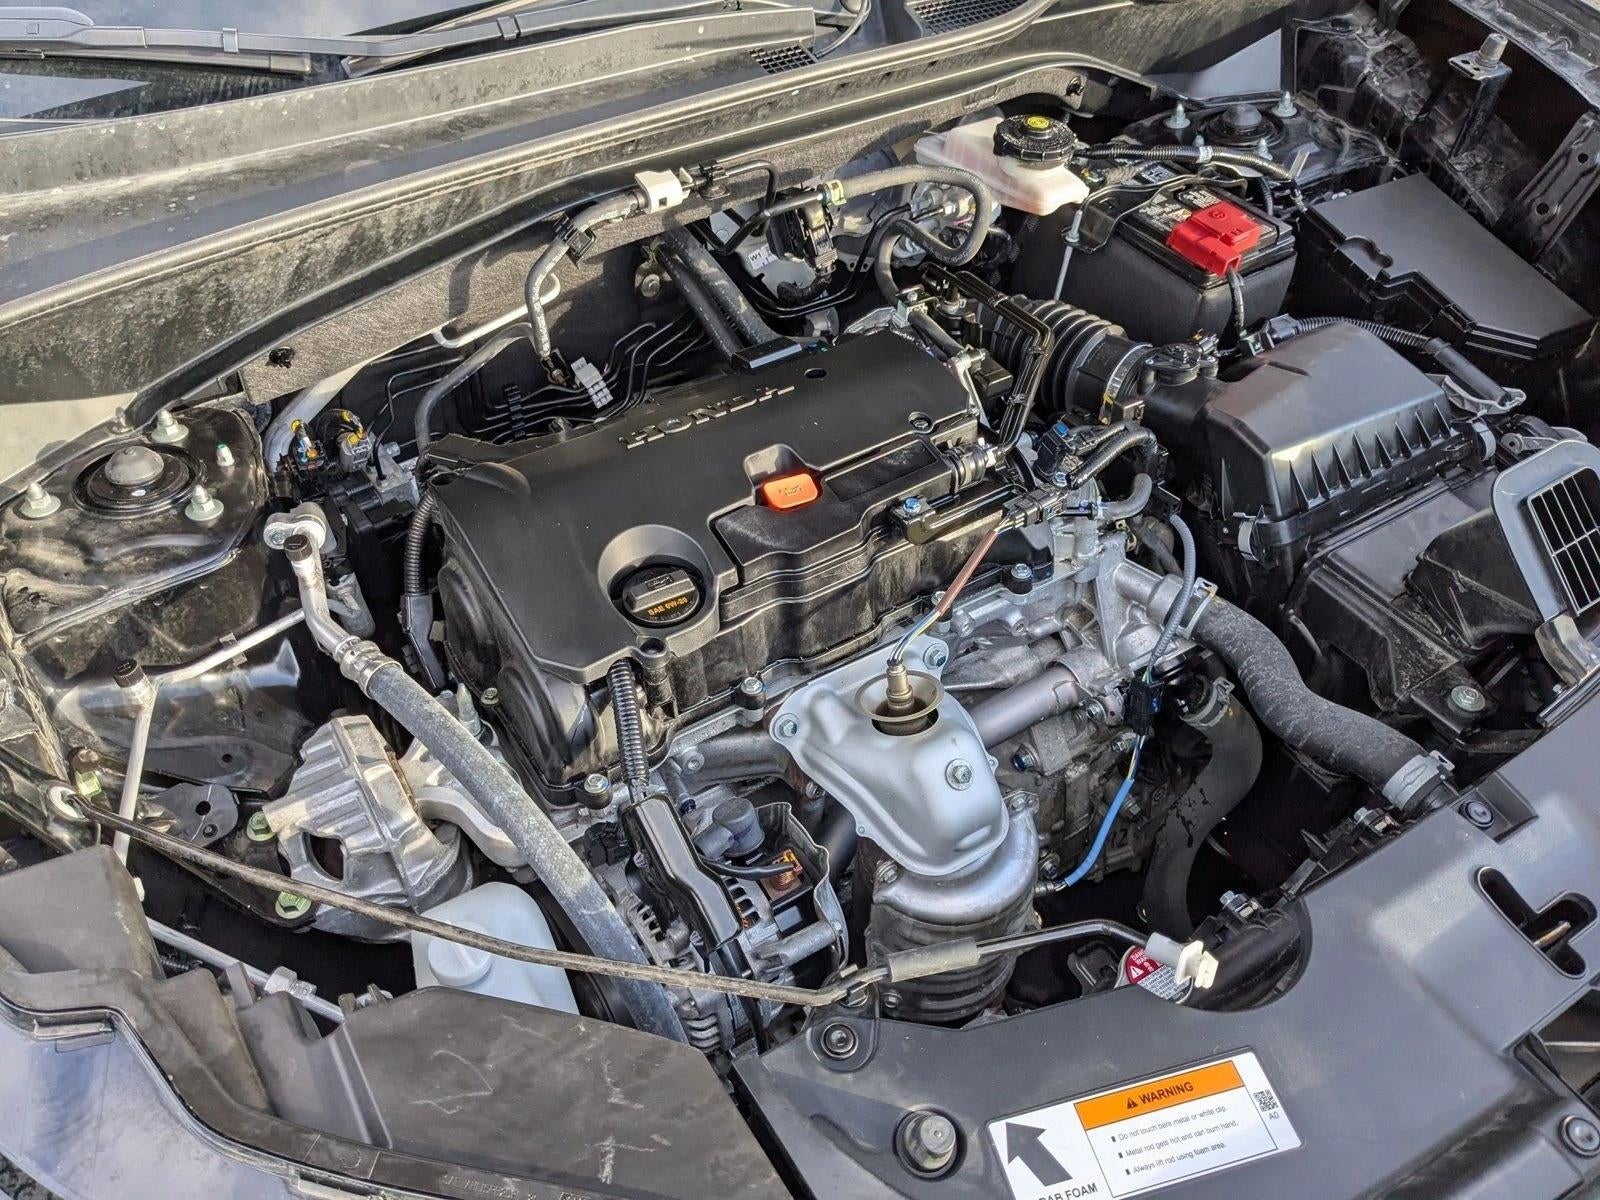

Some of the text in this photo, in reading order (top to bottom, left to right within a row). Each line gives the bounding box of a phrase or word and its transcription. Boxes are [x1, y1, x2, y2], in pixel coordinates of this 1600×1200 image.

[617, 385, 795, 450] HONDA
[1139, 1081, 1194, 1104] WARNING
[1129, 1129, 1139, 1137] not
[1140, 1125, 1157, 1134] touch
[1157, 1121, 1172, 1129] bare
[1172, 1115, 1190, 1125] metal
[1198, 1109, 1214, 1118] white
[1125, 1146, 1143, 1157] Metal
[1144, 1143, 1155, 1152] rod
[1155, 1139, 1169, 1150] gets
[1170, 1136, 1180, 1145] hot
[1181, 1132, 1193, 1141] and
[1194, 1129, 1205, 1137] can
[1205, 1125, 1220, 1134] burn
[1133, 1162, 1155, 1174] Always
[1156, 1158, 1164, 1167] lift
[1164, 1156, 1175, 1165] rod
[1176, 1151, 1194, 1161] using
[1193, 1147, 1210, 1156] foam
[1064, 1183, 1098, 1200] FOAM
